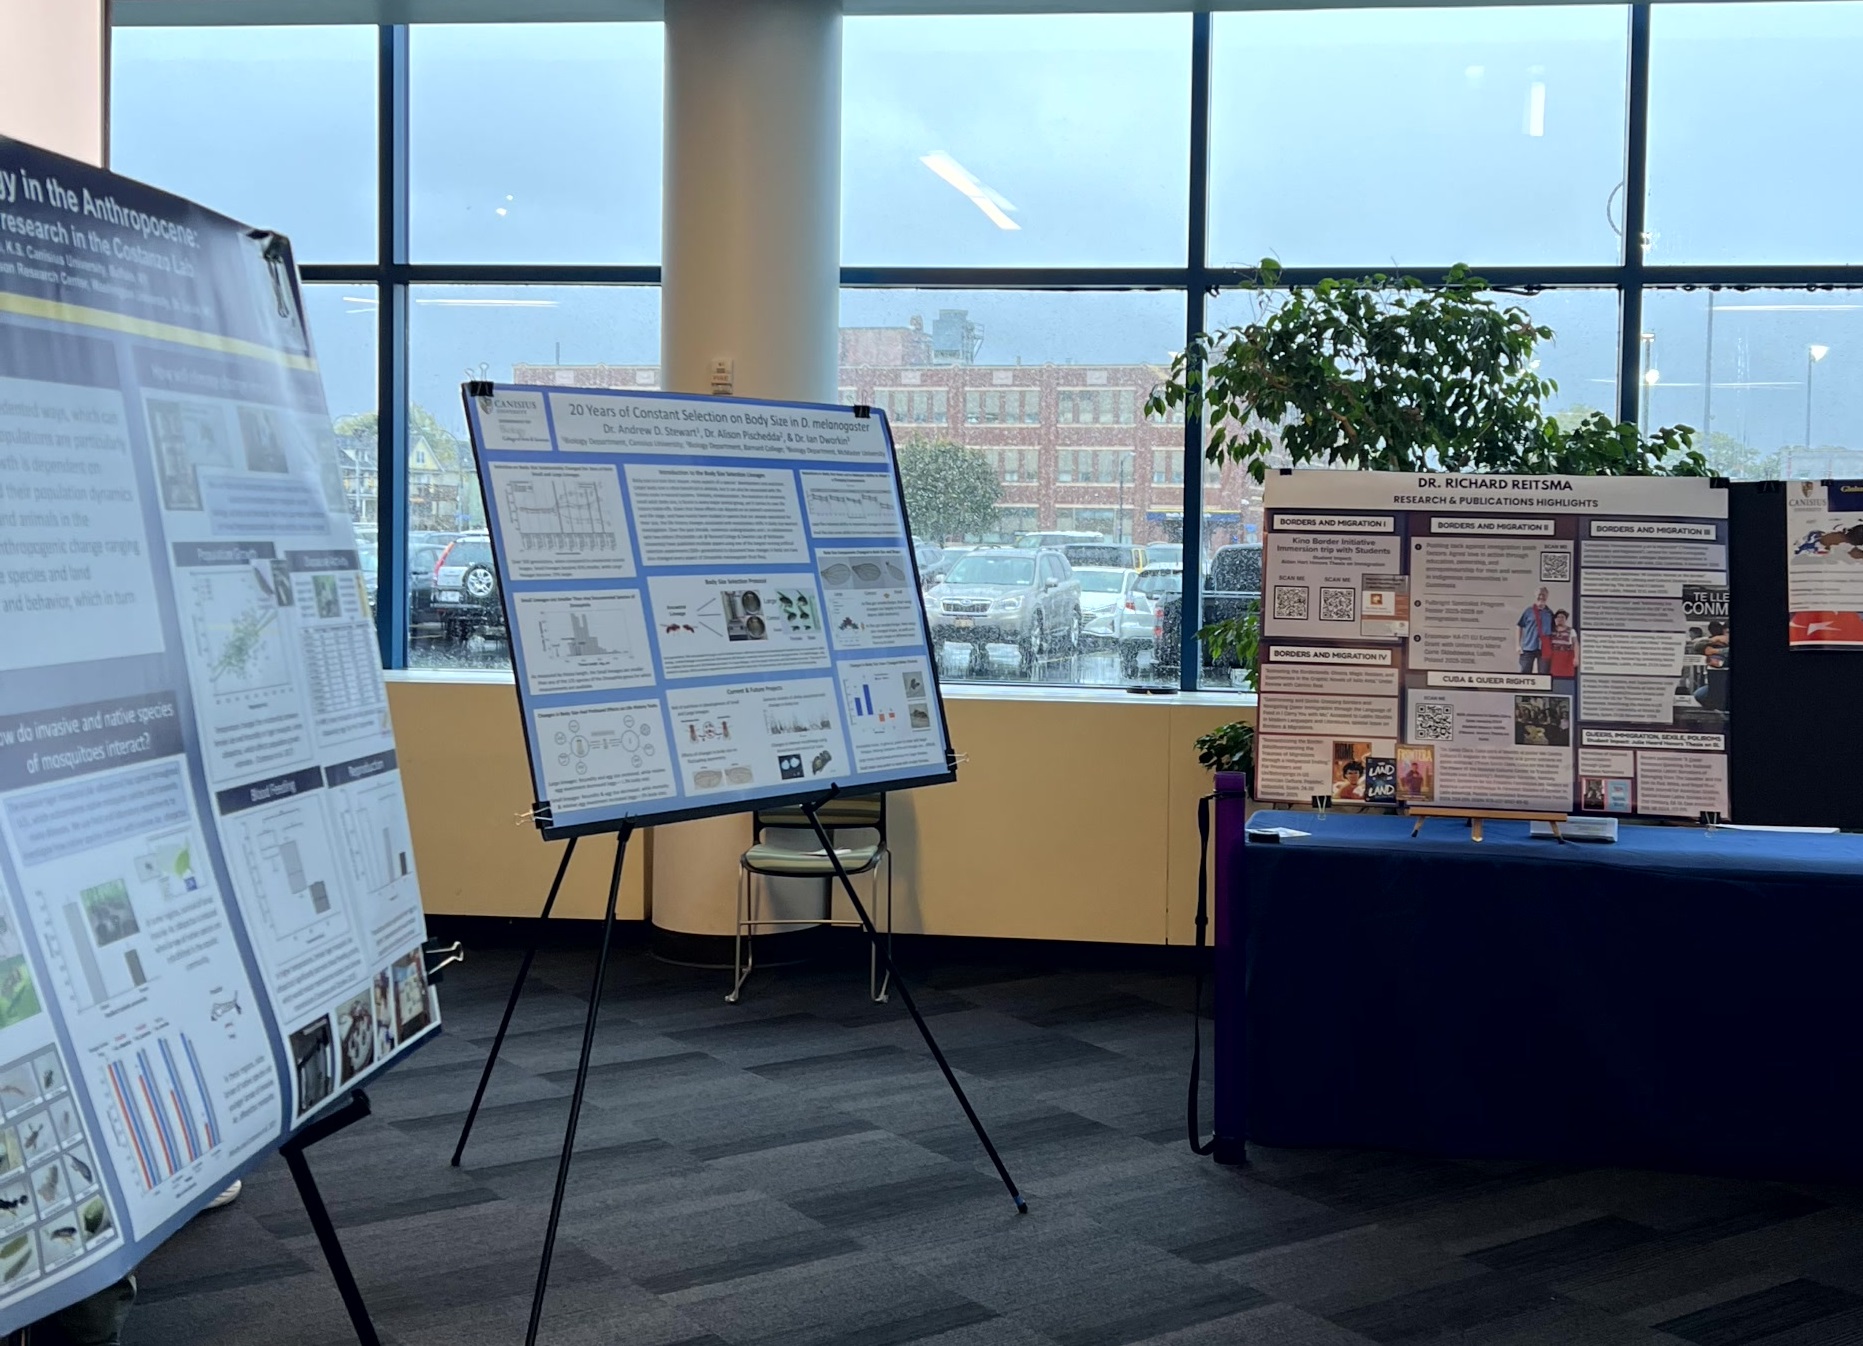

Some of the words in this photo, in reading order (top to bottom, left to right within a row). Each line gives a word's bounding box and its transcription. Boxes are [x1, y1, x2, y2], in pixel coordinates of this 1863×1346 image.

[20, 168, 44, 203] in
[46, 177, 80, 213] the
[83, 188, 200, 248] Anthropocene:
[1, 212, 69, 245] research
[71, 225, 86, 247] in
[88, 230, 112, 256] the
[112, 237, 171, 271] Costanzo
[172, 254, 195, 278] Lab
[494, 400, 537, 410] CANISIUS
[568, 403, 584, 416] 20
[586, 404, 616, 418] Years
[619, 405, 630, 418] of
[633, 406, 680, 421] Constant
[683, 409, 728, 423] Selection
[730, 415, 743, 424] on
[744, 413, 768, 428] Body
[770, 414, 788, 427] Size
[790, 417, 799, 427] in
[801, 417, 810, 429] D.
[812, 419, 870, 434] melanogaster
[603, 423, 616, 434] Dr.
[618, 425, 651, 435] Andrew
[654, 426, 662, 436] D.
[705, 428, 717, 438] Dr.
[717, 430, 742, 440] Alison
[787, 434, 793, 442] &
[794, 434, 805, 443] Dr.
[806, 435, 818, 444] Ian
[1418, 477, 1441, 489] DR.
[1445, 478, 1508, 490] RICHARD
[1512, 480, 1573, 491] REITSMA
[1394, 495, 1447, 505] RESEARCH
[1449, 496, 1456, 505] &
[1459, 497, 1534, 507] PUBLICATIONS
[1537, 499, 1599, 508] HIGHLIGHTS
[1280, 518, 1316, 526] BORDERS
[1318, 519, 1336, 527] AND
[1438, 521, 1475, 530] BORDERS
[1477, 522, 1495, 530] AND
[1497, 523, 1543, 531] MIGRATION
[1596, 525, 1635, 533] BORDERS
[1656, 527, 1702, 535] MIGRATION
[1341, 538, 1376, 546] Initiative
[1277, 545, 1318, 553] Immersion
[1320, 546, 1335, 554] trip
[1355, 547, 1391, 555] Students
[1694, 592, 1709, 602] TE
[1710, 593, 1730, 603] LLE
[1683, 601, 1729, 616] CONM
[1274, 650, 1311, 658] BORDERS
[1312, 651, 1331, 659] AND
[1332, 652, 1377, 660] MIGRATION
[1443, 675, 1466, 683] CUBA
[1476, 676, 1504, 684] QUEER
[1506, 678, 1536, 686] RIGHTS
[17, 722, 33, 743] do
[35, 717, 80, 739] invasive
[82, 711, 103, 731] and
[104, 707, 136, 728] native
[137, 702, 174, 726] species
[26, 752, 41, 774] of
[41, 745, 106, 770] mosquitoes
[106, 731, 152, 757] interact?
[1369, 764, 1395, 777] LAND
[1368, 784, 1395, 797] LAND
